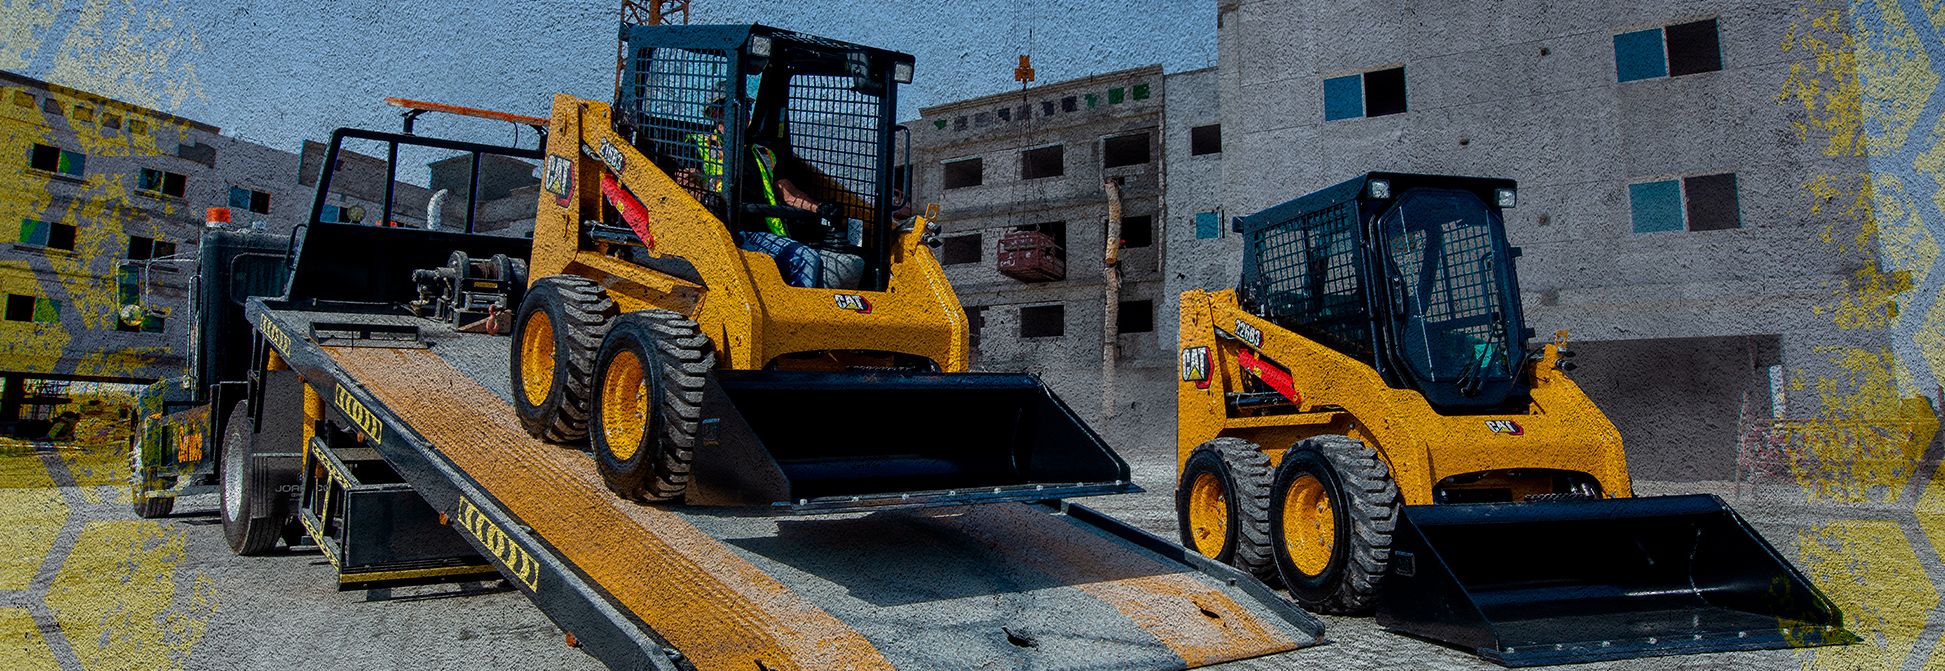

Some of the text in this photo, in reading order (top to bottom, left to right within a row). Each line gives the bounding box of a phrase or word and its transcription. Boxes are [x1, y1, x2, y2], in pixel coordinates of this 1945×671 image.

[546, 155, 570, 196] CAT
[834, 294, 864, 310] CAT
[1235, 318, 1261, 347] 226B3
[1182, 346, 1207, 380] CAT
[1485, 419, 1516, 433] CAT
